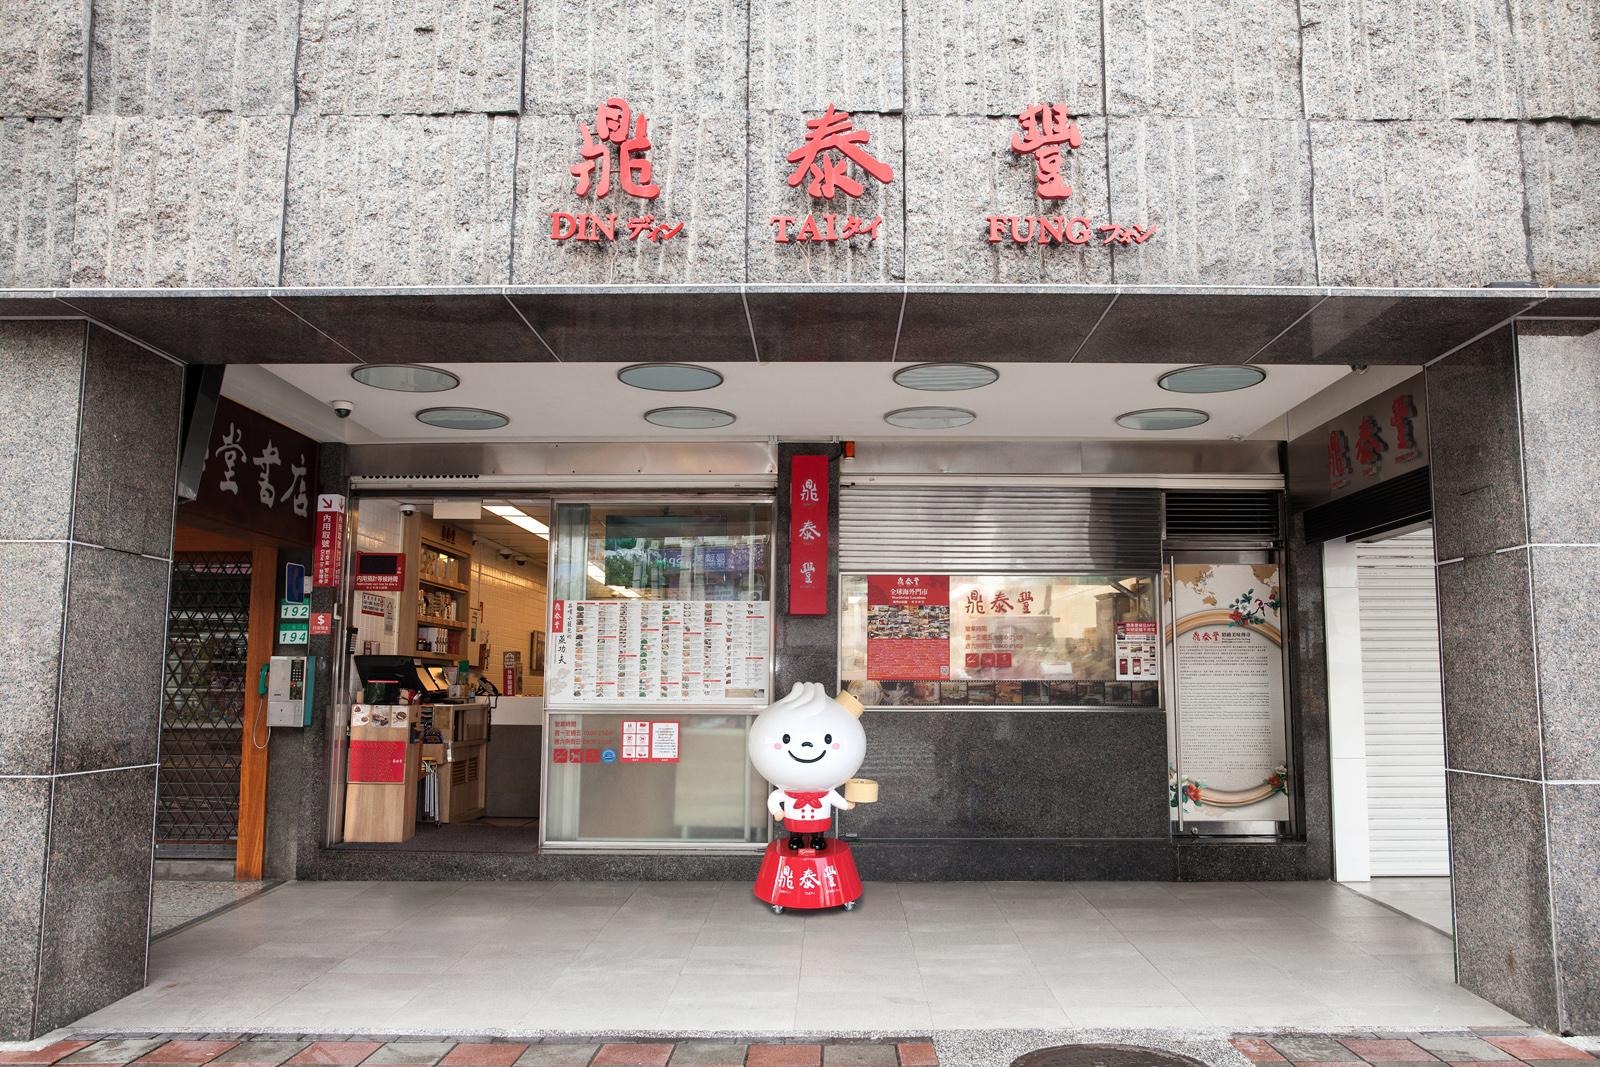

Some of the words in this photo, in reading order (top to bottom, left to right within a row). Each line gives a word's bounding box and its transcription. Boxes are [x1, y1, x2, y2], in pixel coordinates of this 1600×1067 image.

[550, 211, 617, 242] DIN
[627, 213, 685, 244] ディン
[770, 213, 838, 244] TAI
[843, 215, 883, 241] タイ
[986, 215, 1092, 245] FUNG
[1099, 223, 1159, 247] フォン
[202, 422, 309, 518] 堂書店
[798, 478, 821, 584] 鼎泰豐
[283, 606, 308, 617] 192
[964, 589, 1034, 614] 鼎泰豐
[281, 632, 306, 643] 194
[777, 865, 837, 890] 鼎泰豐
